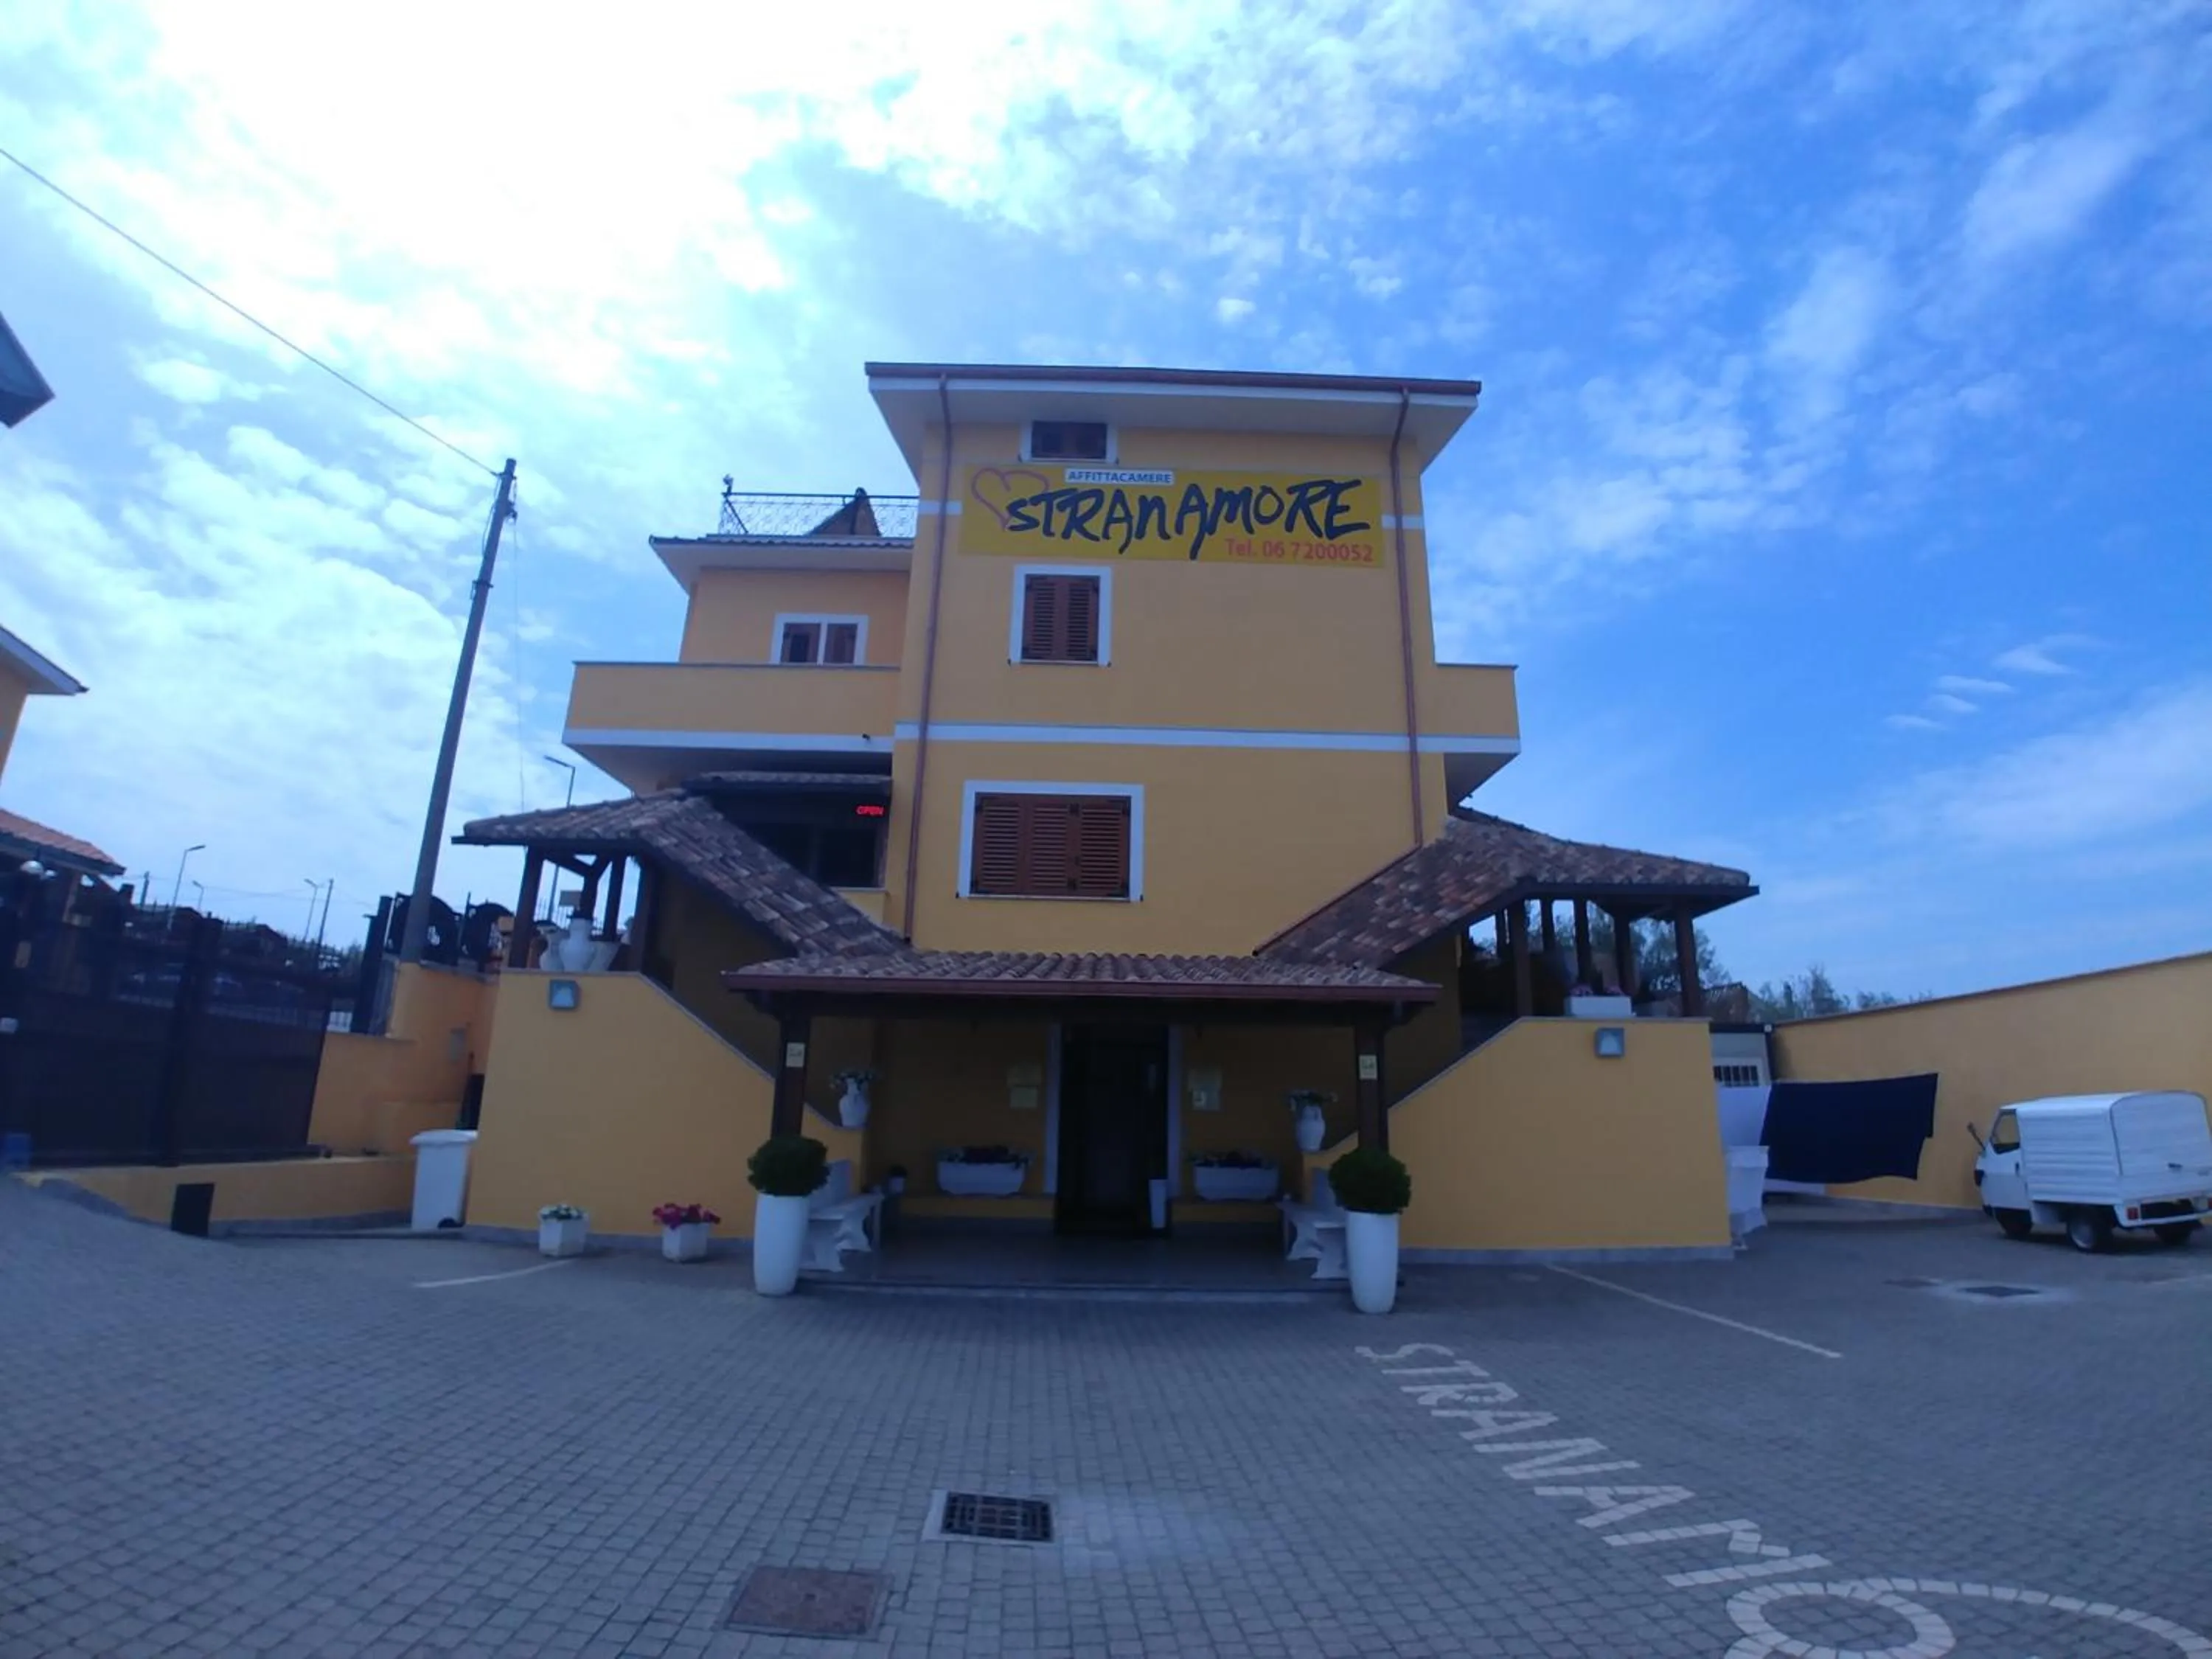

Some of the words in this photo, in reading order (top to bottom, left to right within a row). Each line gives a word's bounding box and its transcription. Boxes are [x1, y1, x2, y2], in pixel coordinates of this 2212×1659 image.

[1068, 470, 1172, 483] AFFITTACAMERE
[1225, 538, 1256, 557] Tel.
[1263, 540, 1284, 558] 06
[1290, 541, 1374, 563] 7200052
[856, 805, 884, 816] OPEN
